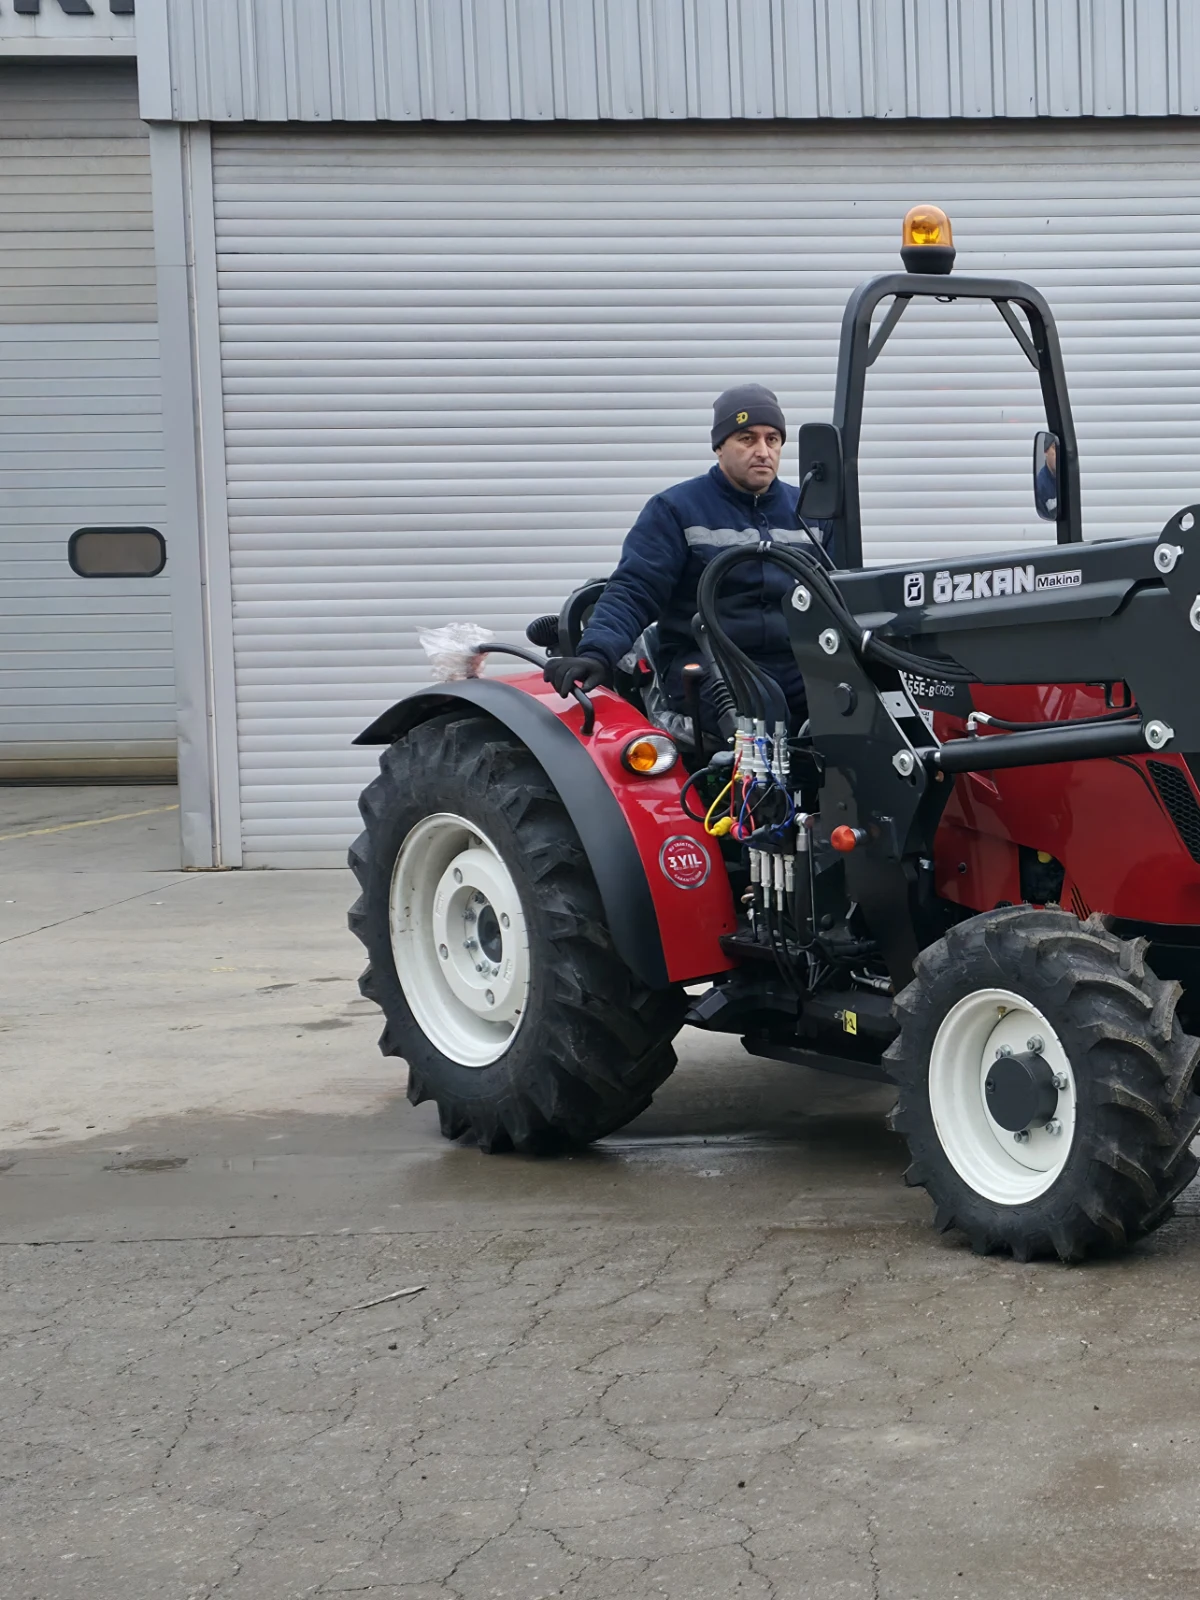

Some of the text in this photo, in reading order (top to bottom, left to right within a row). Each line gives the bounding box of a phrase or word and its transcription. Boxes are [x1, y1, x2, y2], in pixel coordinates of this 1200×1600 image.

[933, 565, 1080, 603] ÖZKAN Makina
[667, 854, 702, 869] 3 YIL
